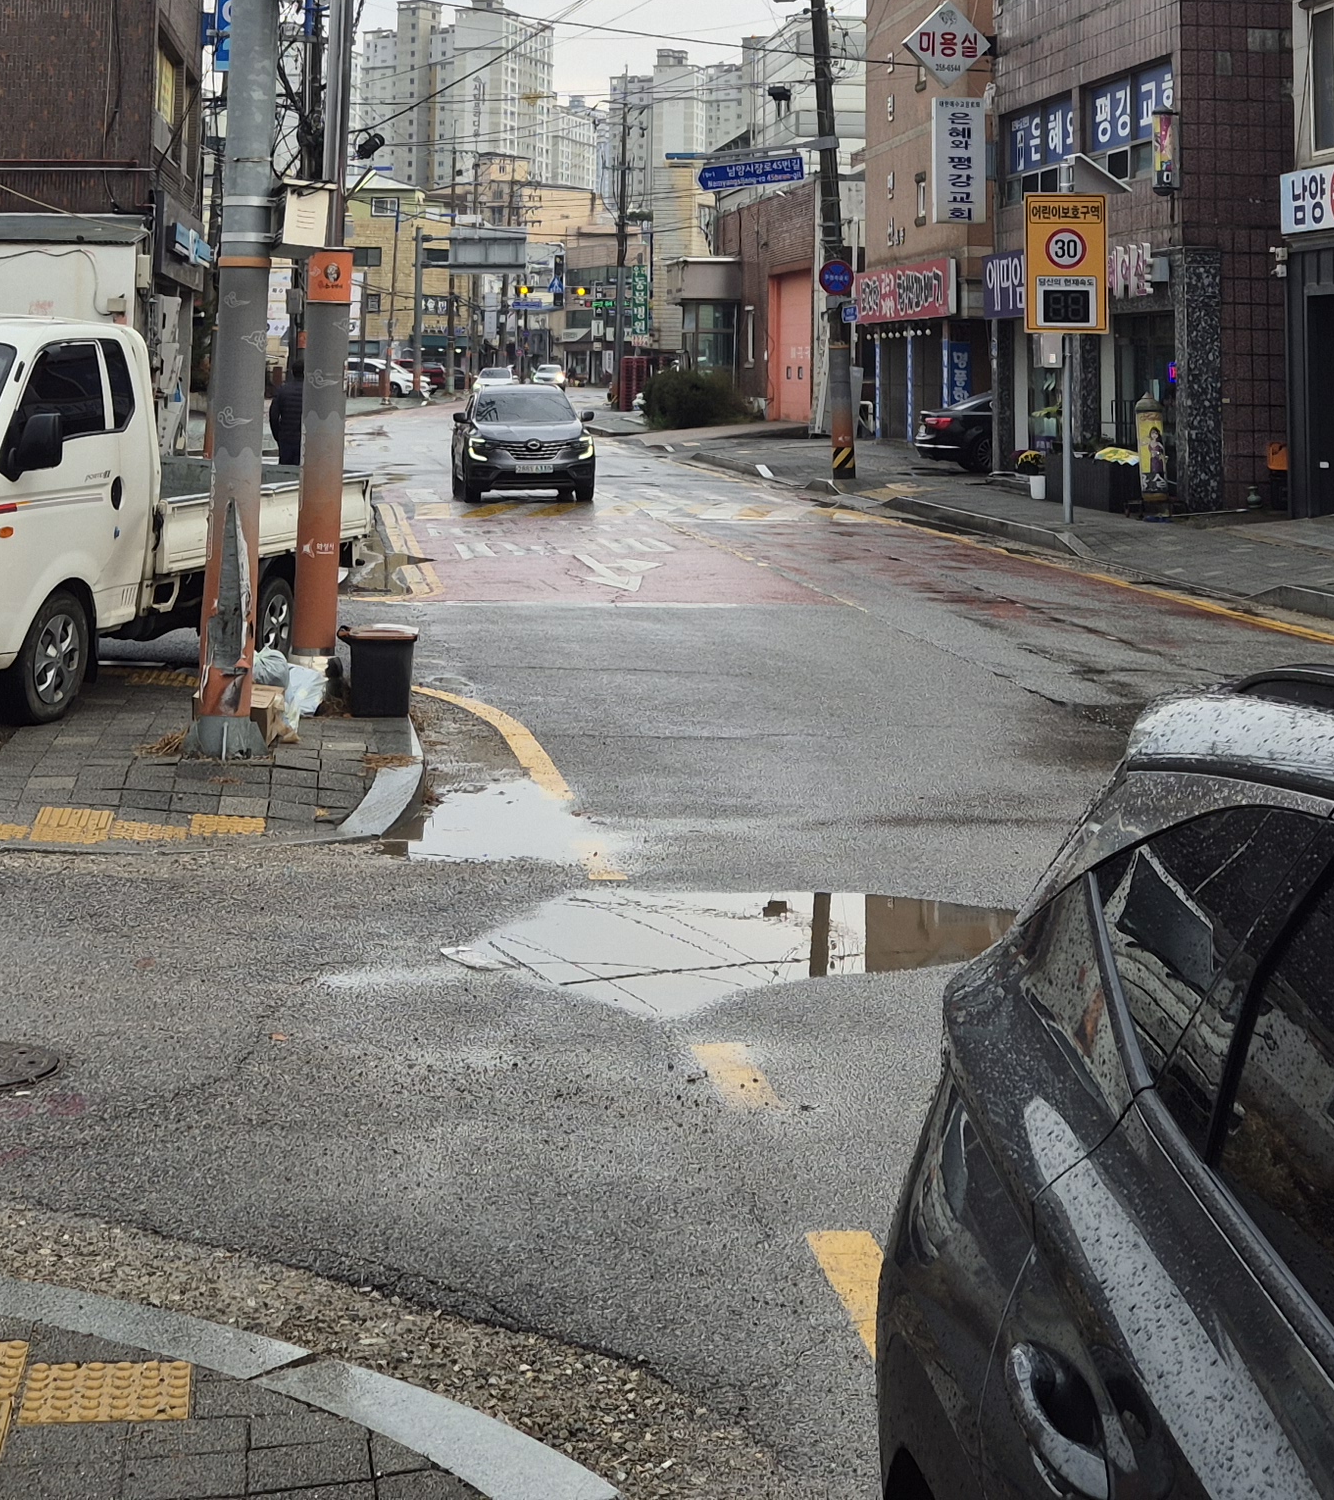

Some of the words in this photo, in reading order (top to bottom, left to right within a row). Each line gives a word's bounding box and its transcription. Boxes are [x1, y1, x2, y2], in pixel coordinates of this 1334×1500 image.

[919, 31, 978, 58] 미용실
[1291, 172, 1325, 226] 남양
[1031, 205, 1100, 220] 어린이보호구역
[1054, 238, 1078, 259] 30
[1038, 278, 1061, 286] 당신의
[1064, 278, 1094, 286] 현재속도
